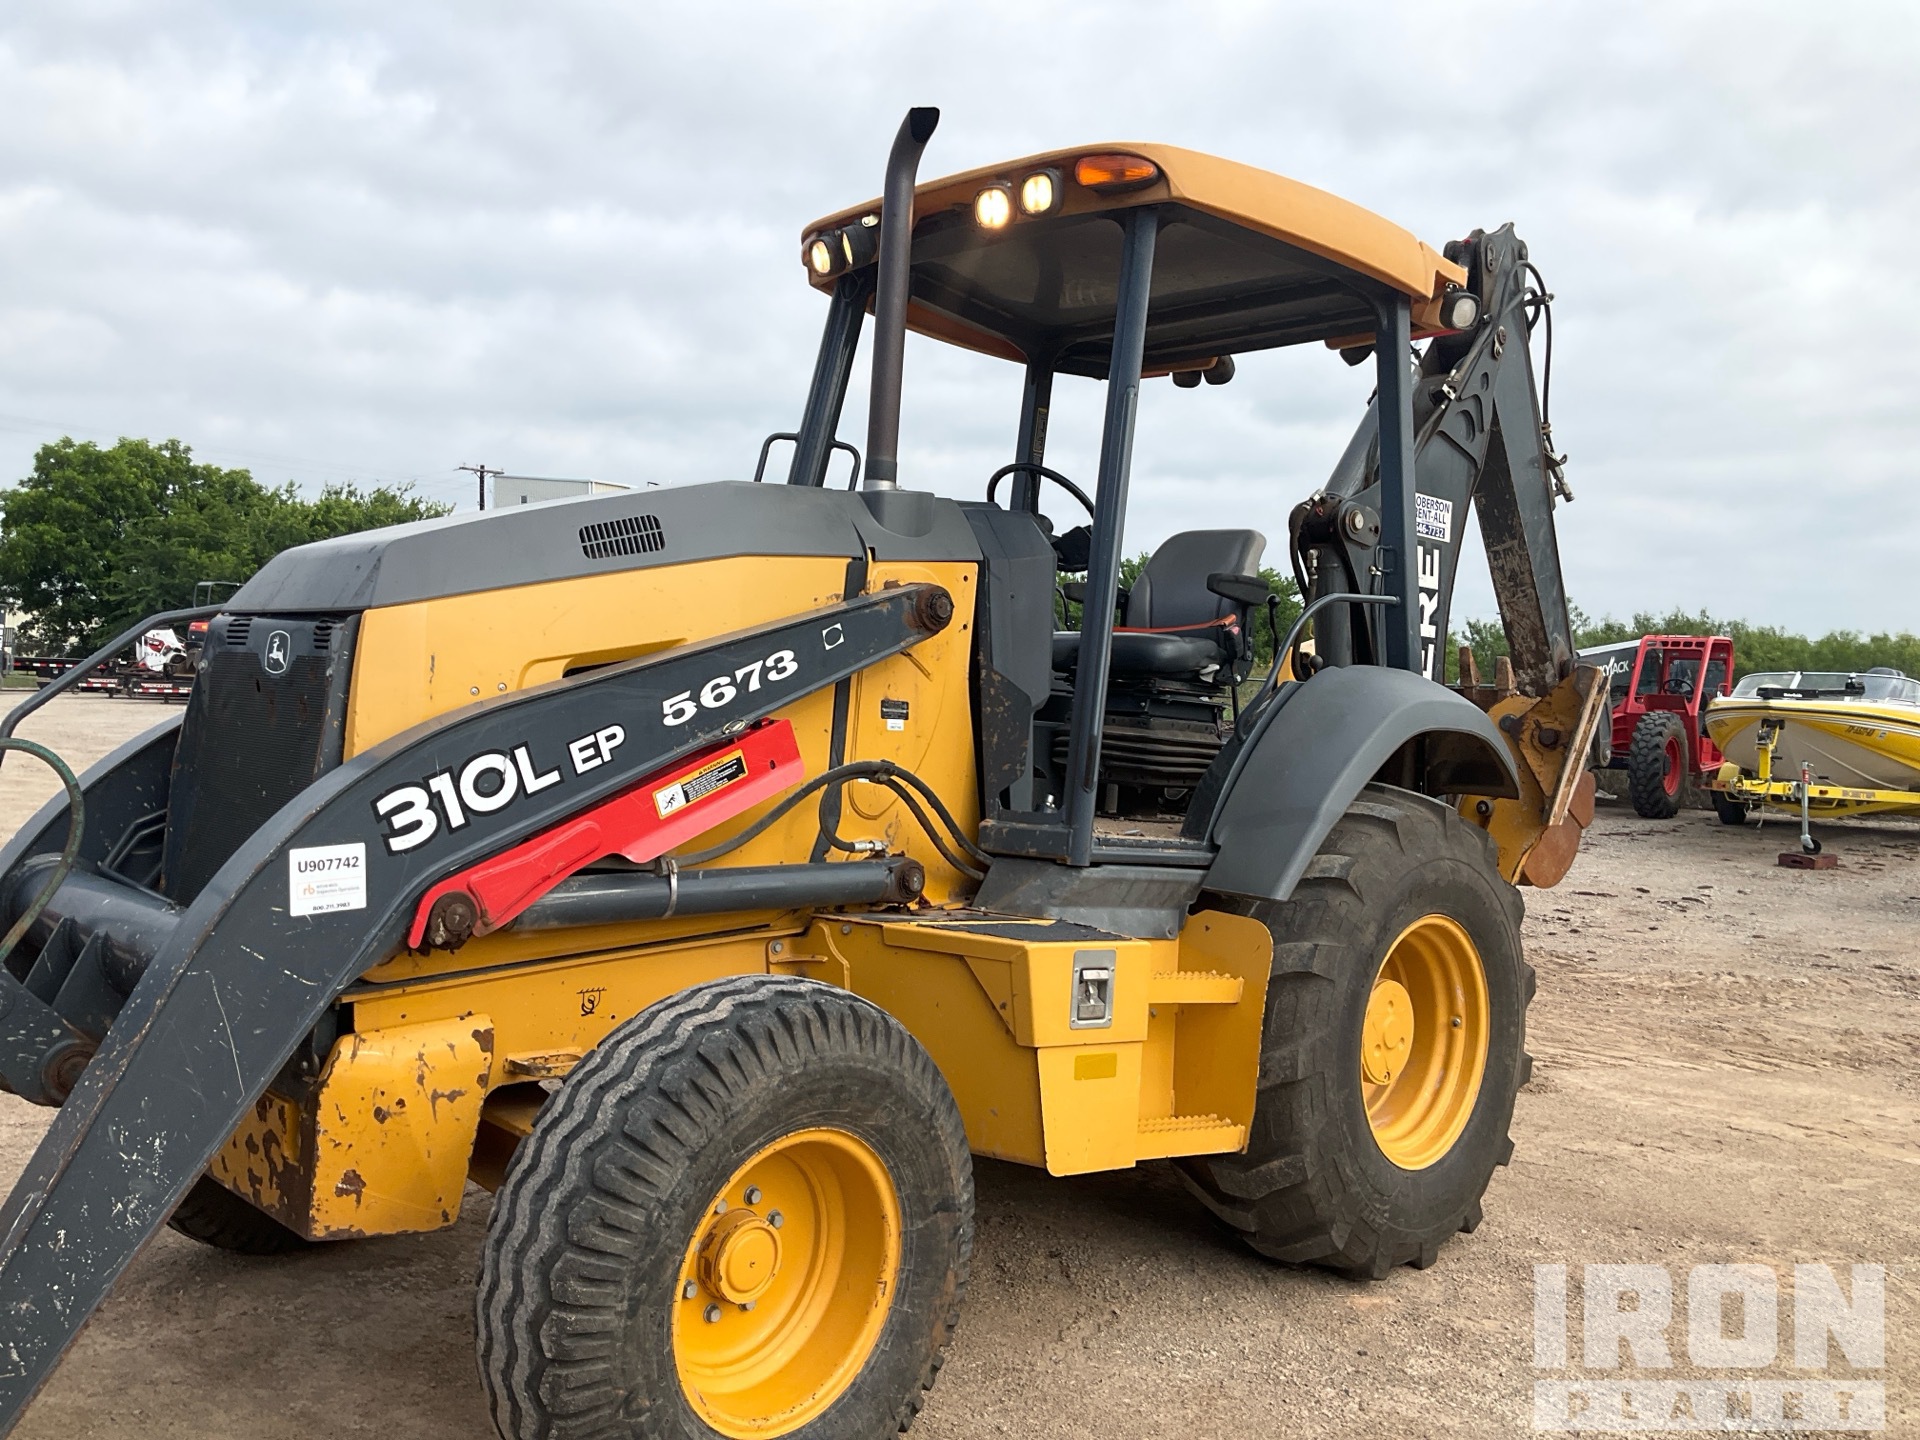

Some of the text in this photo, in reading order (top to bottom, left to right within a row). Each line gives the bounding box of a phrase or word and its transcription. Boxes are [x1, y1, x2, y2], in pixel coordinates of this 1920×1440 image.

[1416, 496, 1450, 514] OBERSON
[1417, 545, 1439, 681] ERE
[1597, 656, 1629, 676] KYJACK
[662, 649, 799, 727] 5673
[376, 725, 626, 852] 310L EP
[298, 856, 359, 873] U907742
[303, 883, 315, 895] rb
